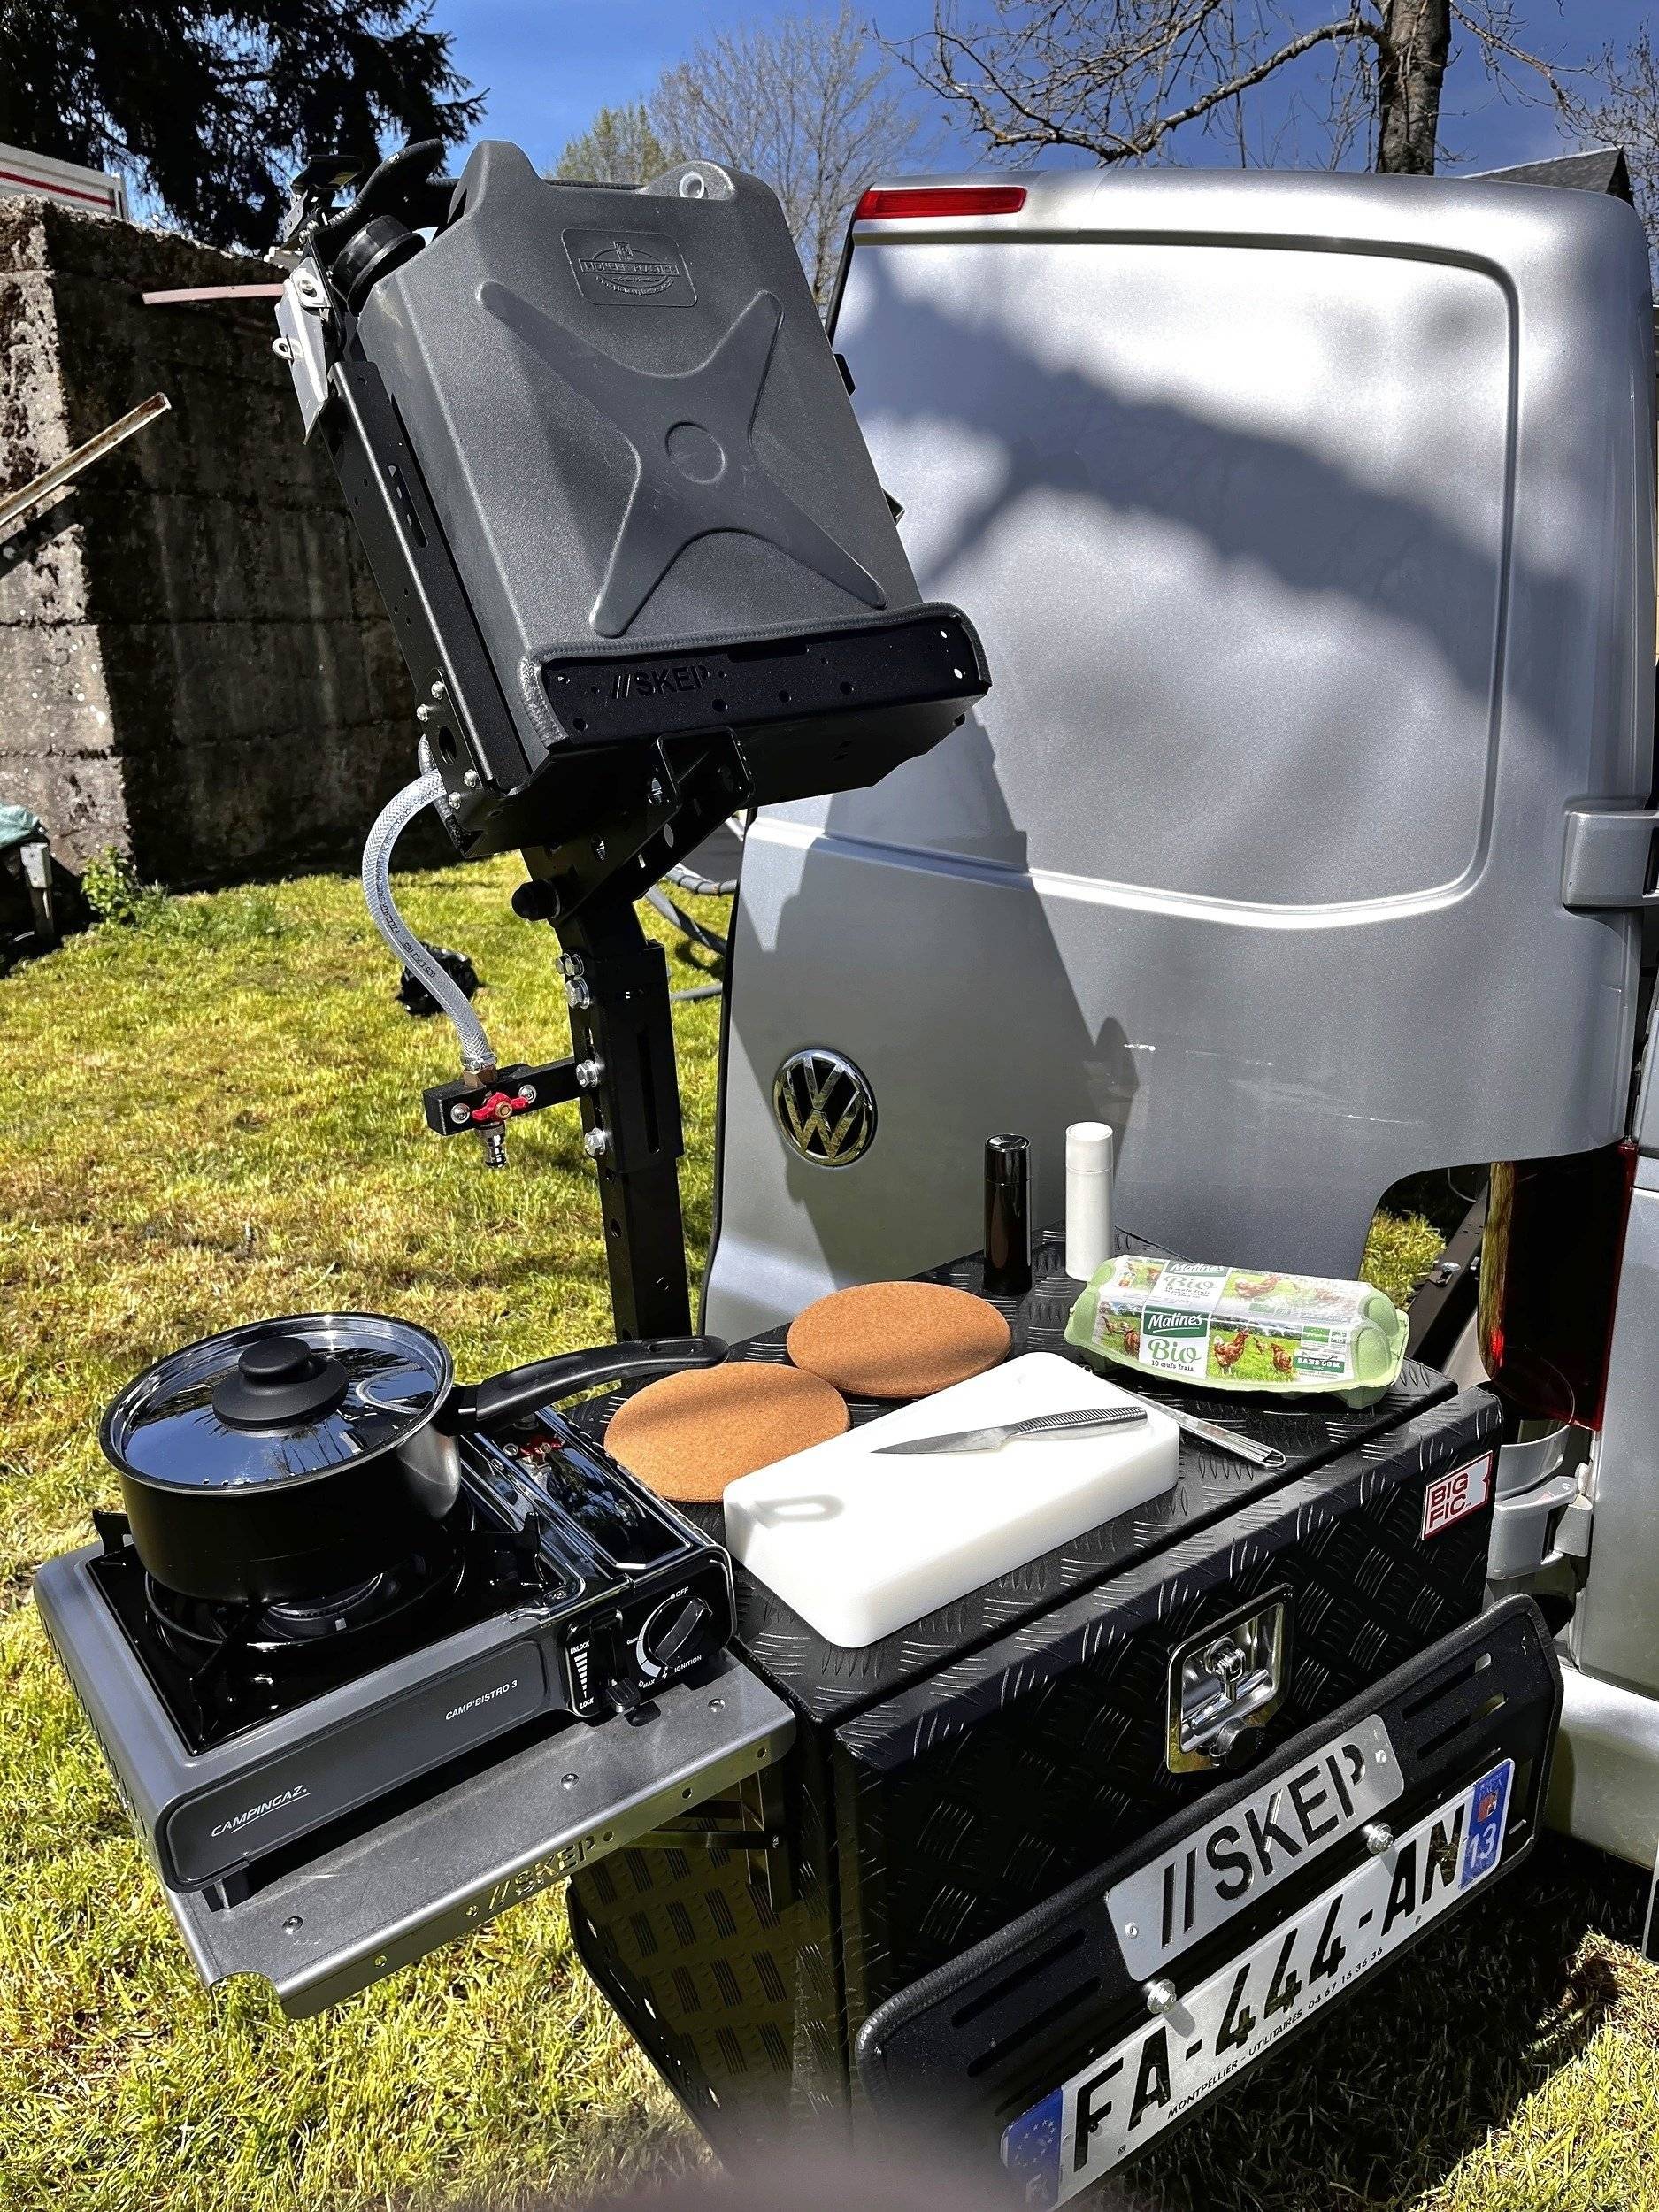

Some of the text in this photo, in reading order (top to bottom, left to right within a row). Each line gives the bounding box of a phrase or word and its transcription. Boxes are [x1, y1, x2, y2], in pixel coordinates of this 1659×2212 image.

[1164, 1275, 1215, 1289] Bio
[1148, 1312, 1202, 1330] Matines
[1148, 1338, 1202, 1363] Bio
[1431, 1472, 1469, 1509] BIG
[675, 1586, 689, 1597] OFF
[570, 1640, 590, 1655] UNLOCK
[674, 1655, 702, 1673] IGNITION
[445, 1679, 518, 1720] CAMP'BISTRO 3
[580, 1696, 595, 1709] LOCK
[1470, 1823, 1497, 1869] 13
[1072, 1802, 1466, 2173] FA-444-AN
[1167, 2061, 1239, 2120] MONTPELLIER
[1248, 2008, 1302, 2057] UTILITAIRES
[1308, 1996, 1322, 2010] 04
[1324, 1982, 1338, 1998] 67
[1341, 1971, 1353, 1984] 16
[1356, 1960, 1368, 1973] 36
[1371, 1946, 1383, 1961] 36
